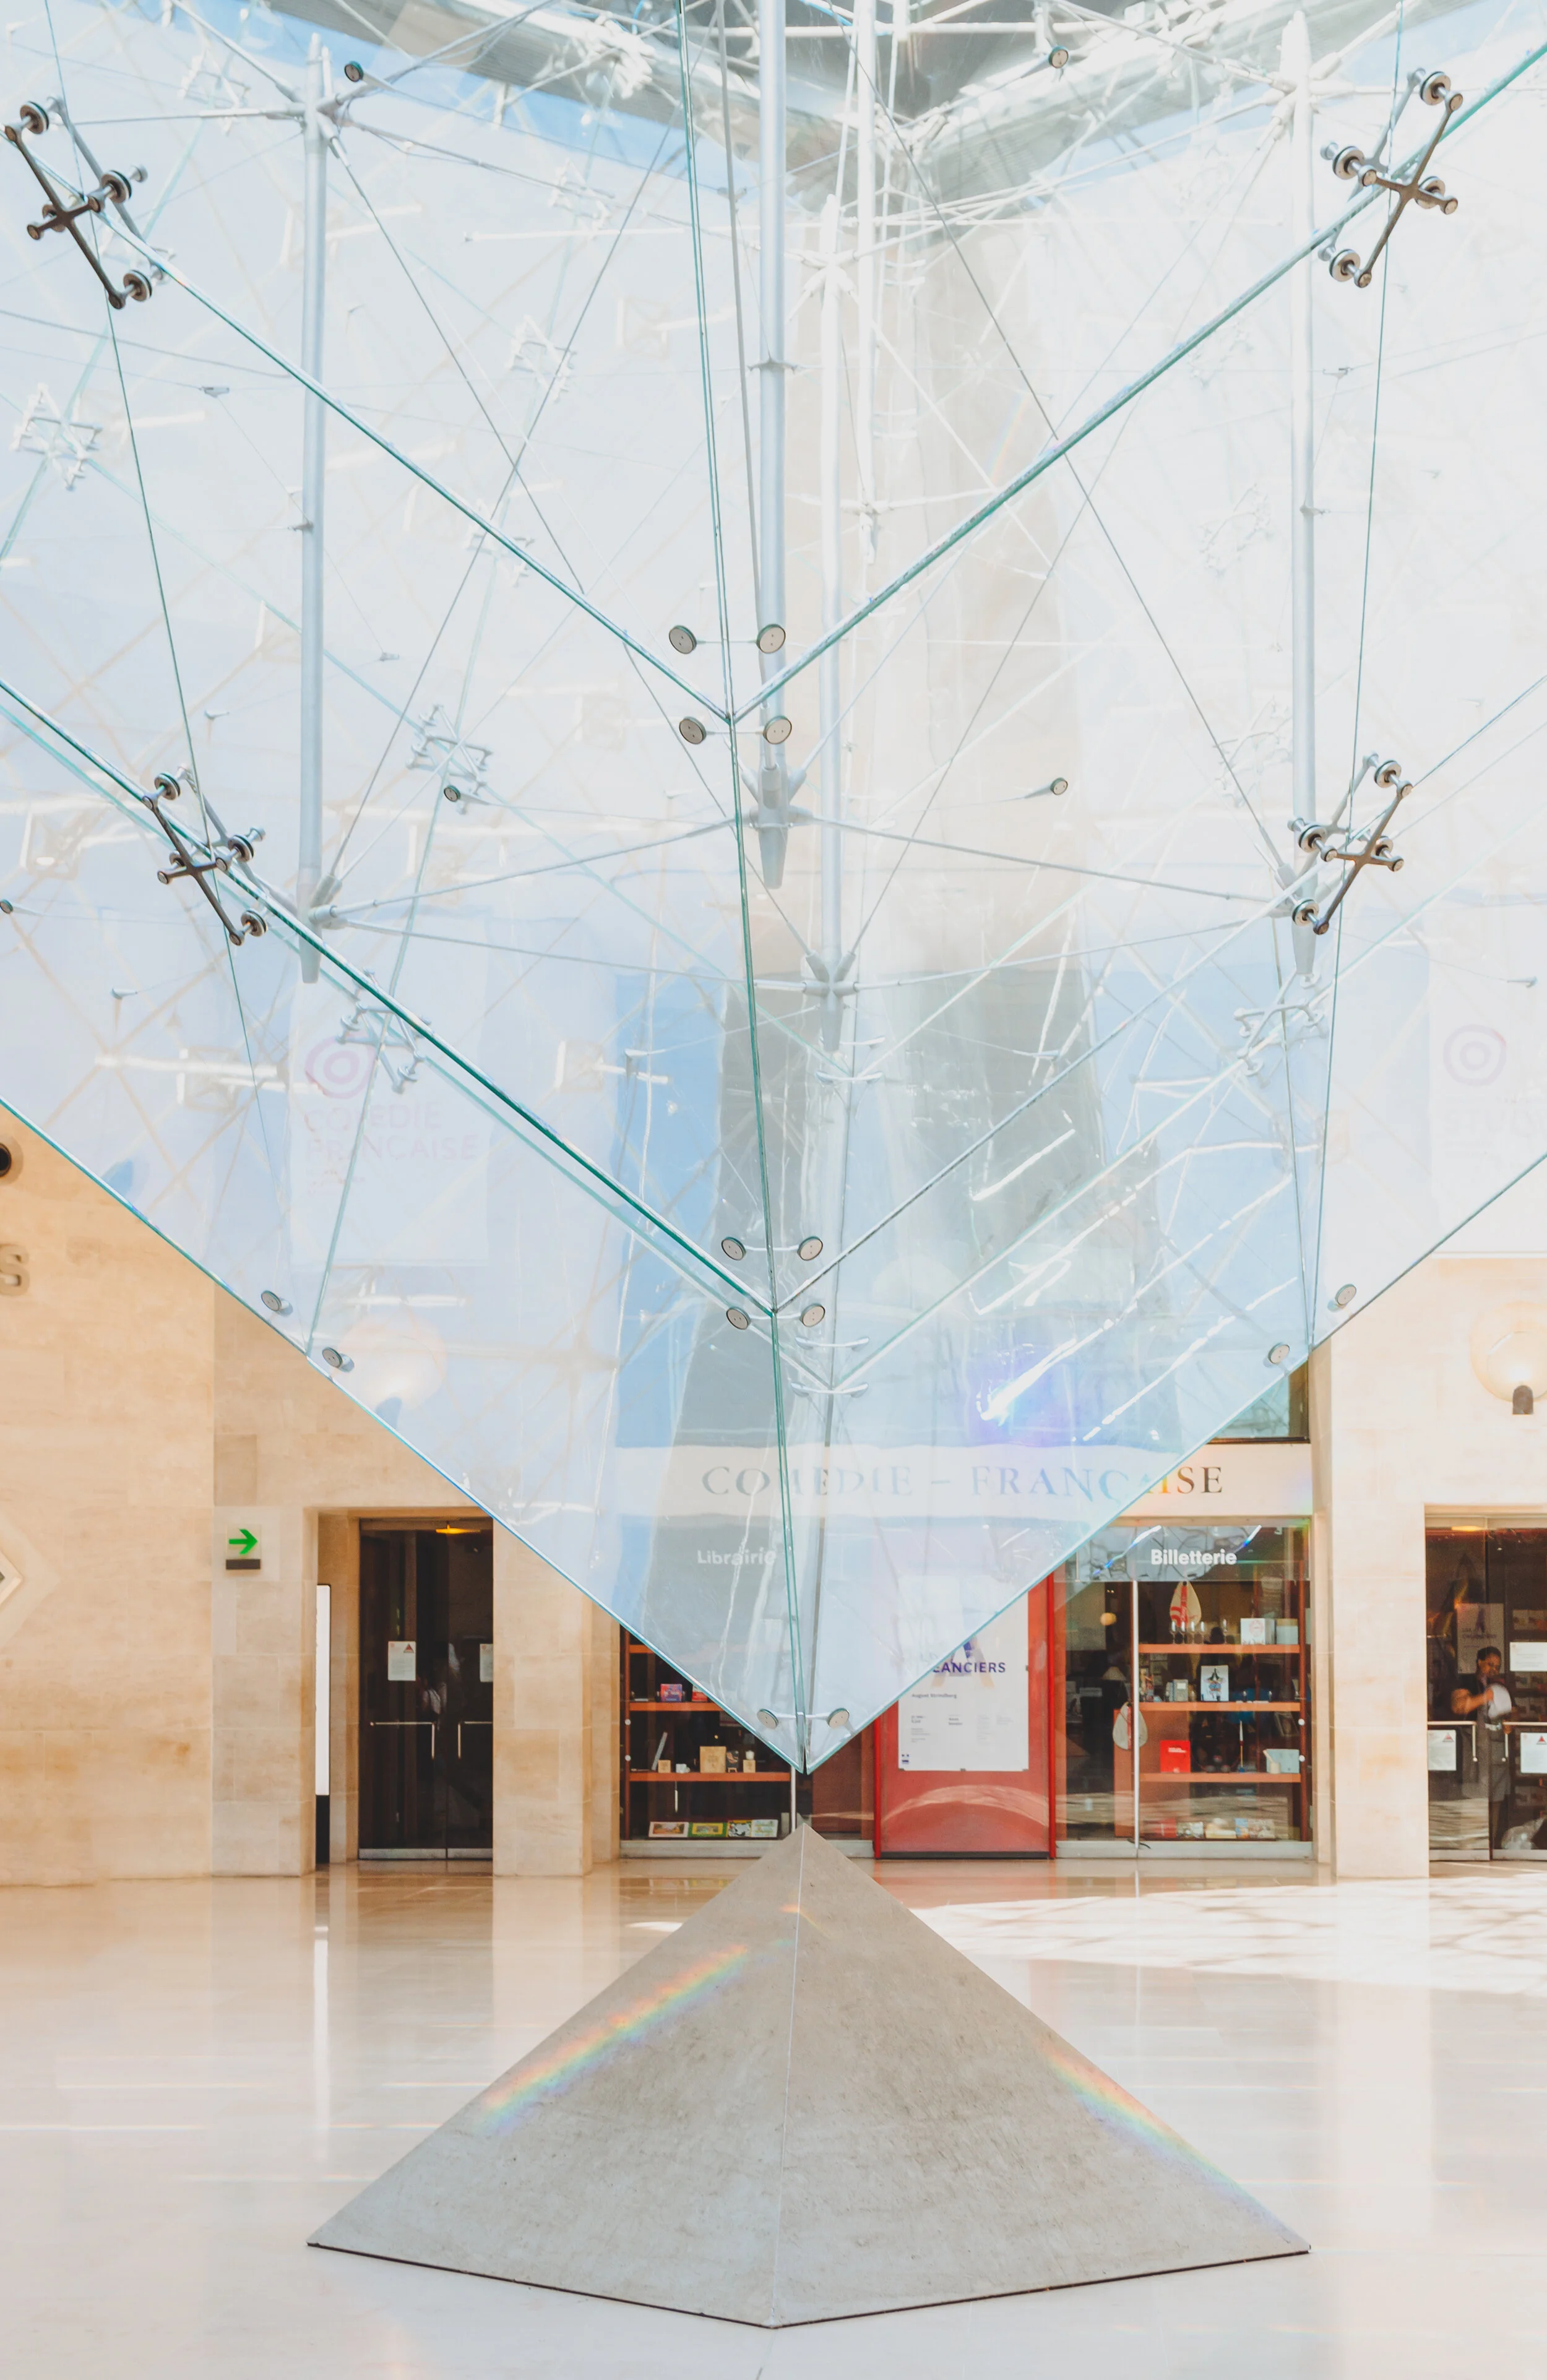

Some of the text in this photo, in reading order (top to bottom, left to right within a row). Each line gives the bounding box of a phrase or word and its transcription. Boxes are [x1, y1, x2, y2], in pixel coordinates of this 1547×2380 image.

[303, 1102, 441, 1132] COEDIE
[697, 1547, 776, 1566] Librairie
[1151, 1548, 1238, 1565] Billetterie
